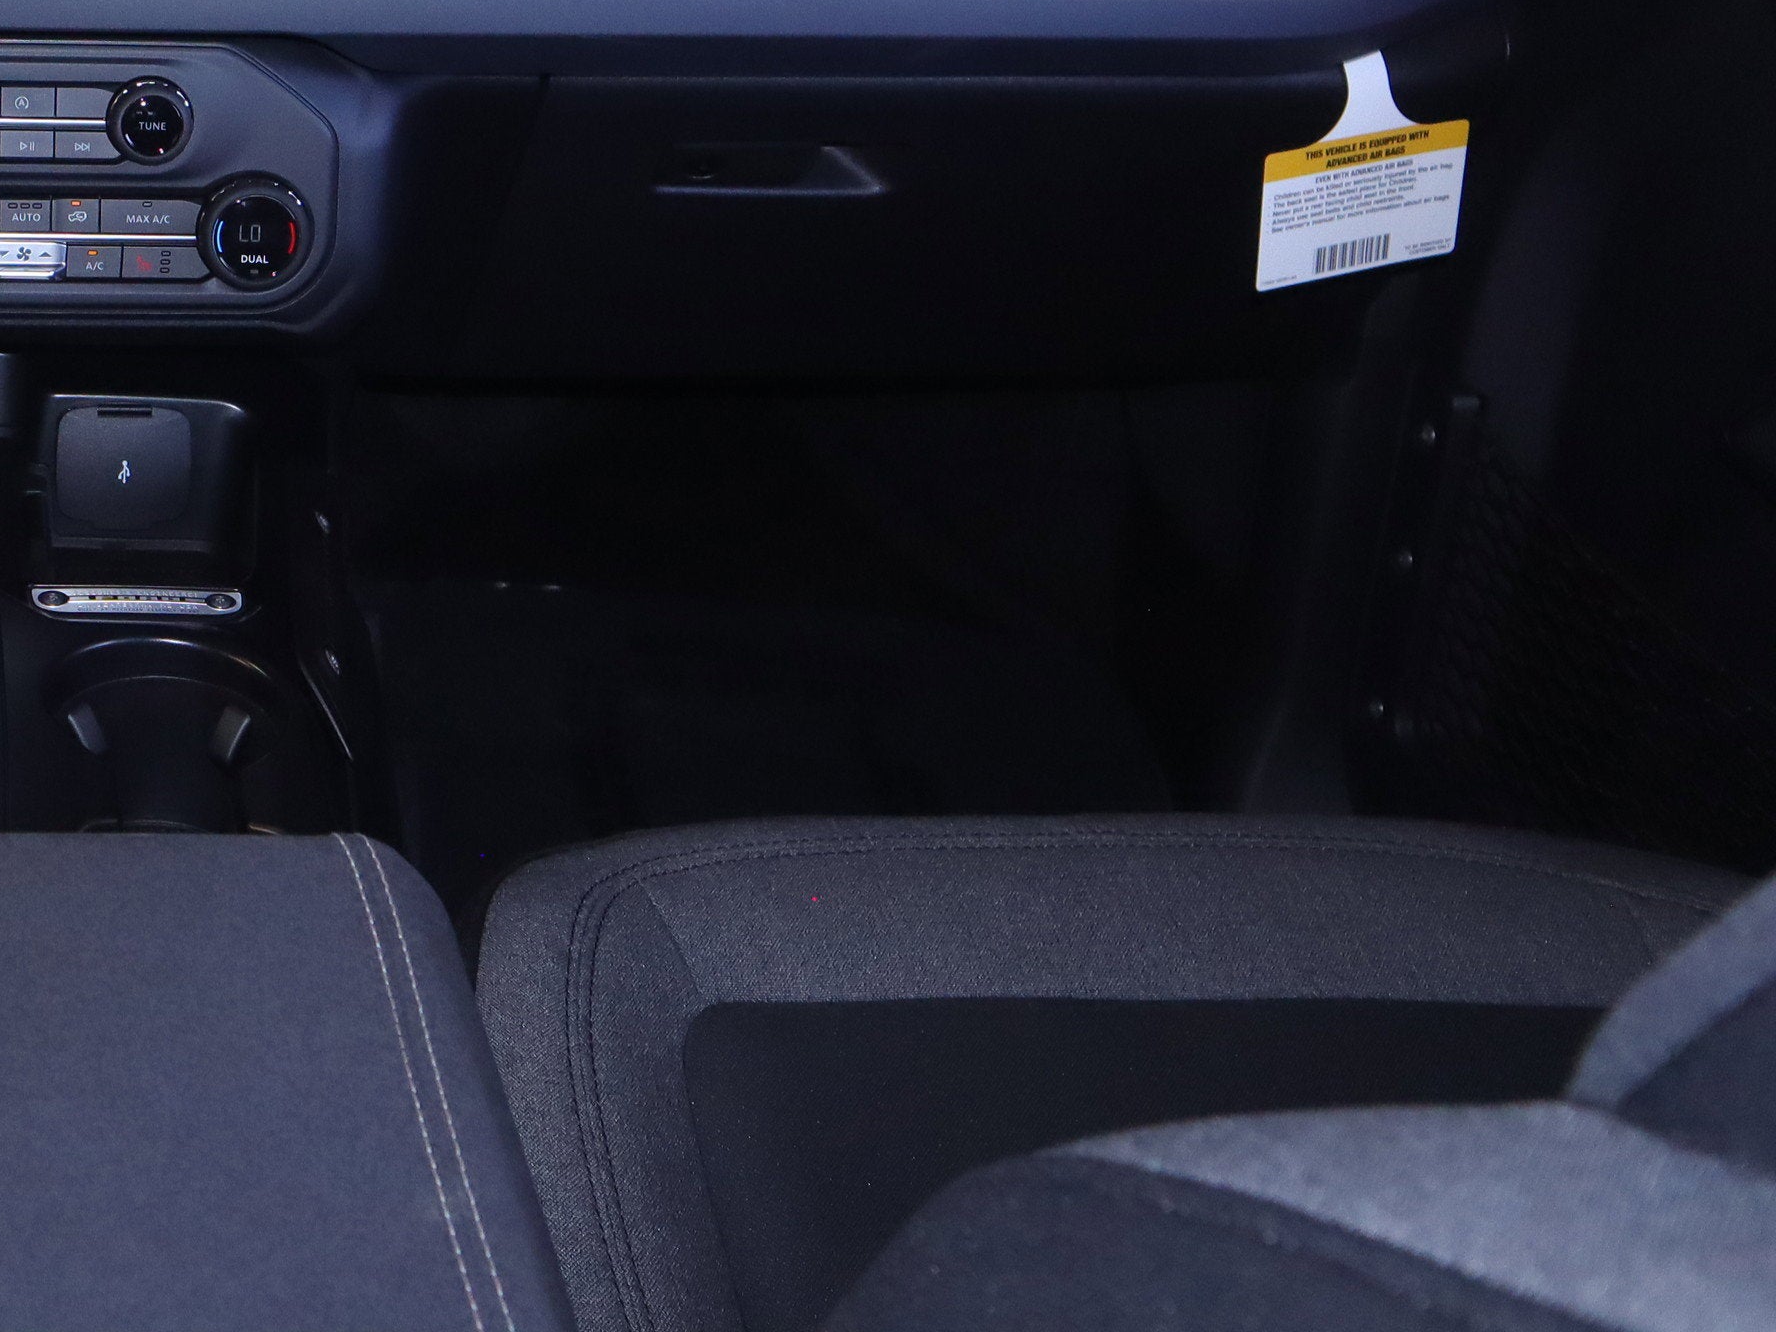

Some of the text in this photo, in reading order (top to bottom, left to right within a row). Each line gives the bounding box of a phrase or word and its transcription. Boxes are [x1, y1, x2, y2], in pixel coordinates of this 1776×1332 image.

[139, 121, 167, 131] TUNE
[1306, 130, 1430, 160] THIS VEHICLE IS EQUIPPED WITH
[1326, 146, 1406, 168] ADVANCED AIR BAGS
[12, 212, 41, 222] AUTO
[126, 214, 170, 224] MAX A/C
[239, 224, 261, 243] LO
[241, 254, 269, 264] DUAL
[85, 261, 104, 271] A/C
